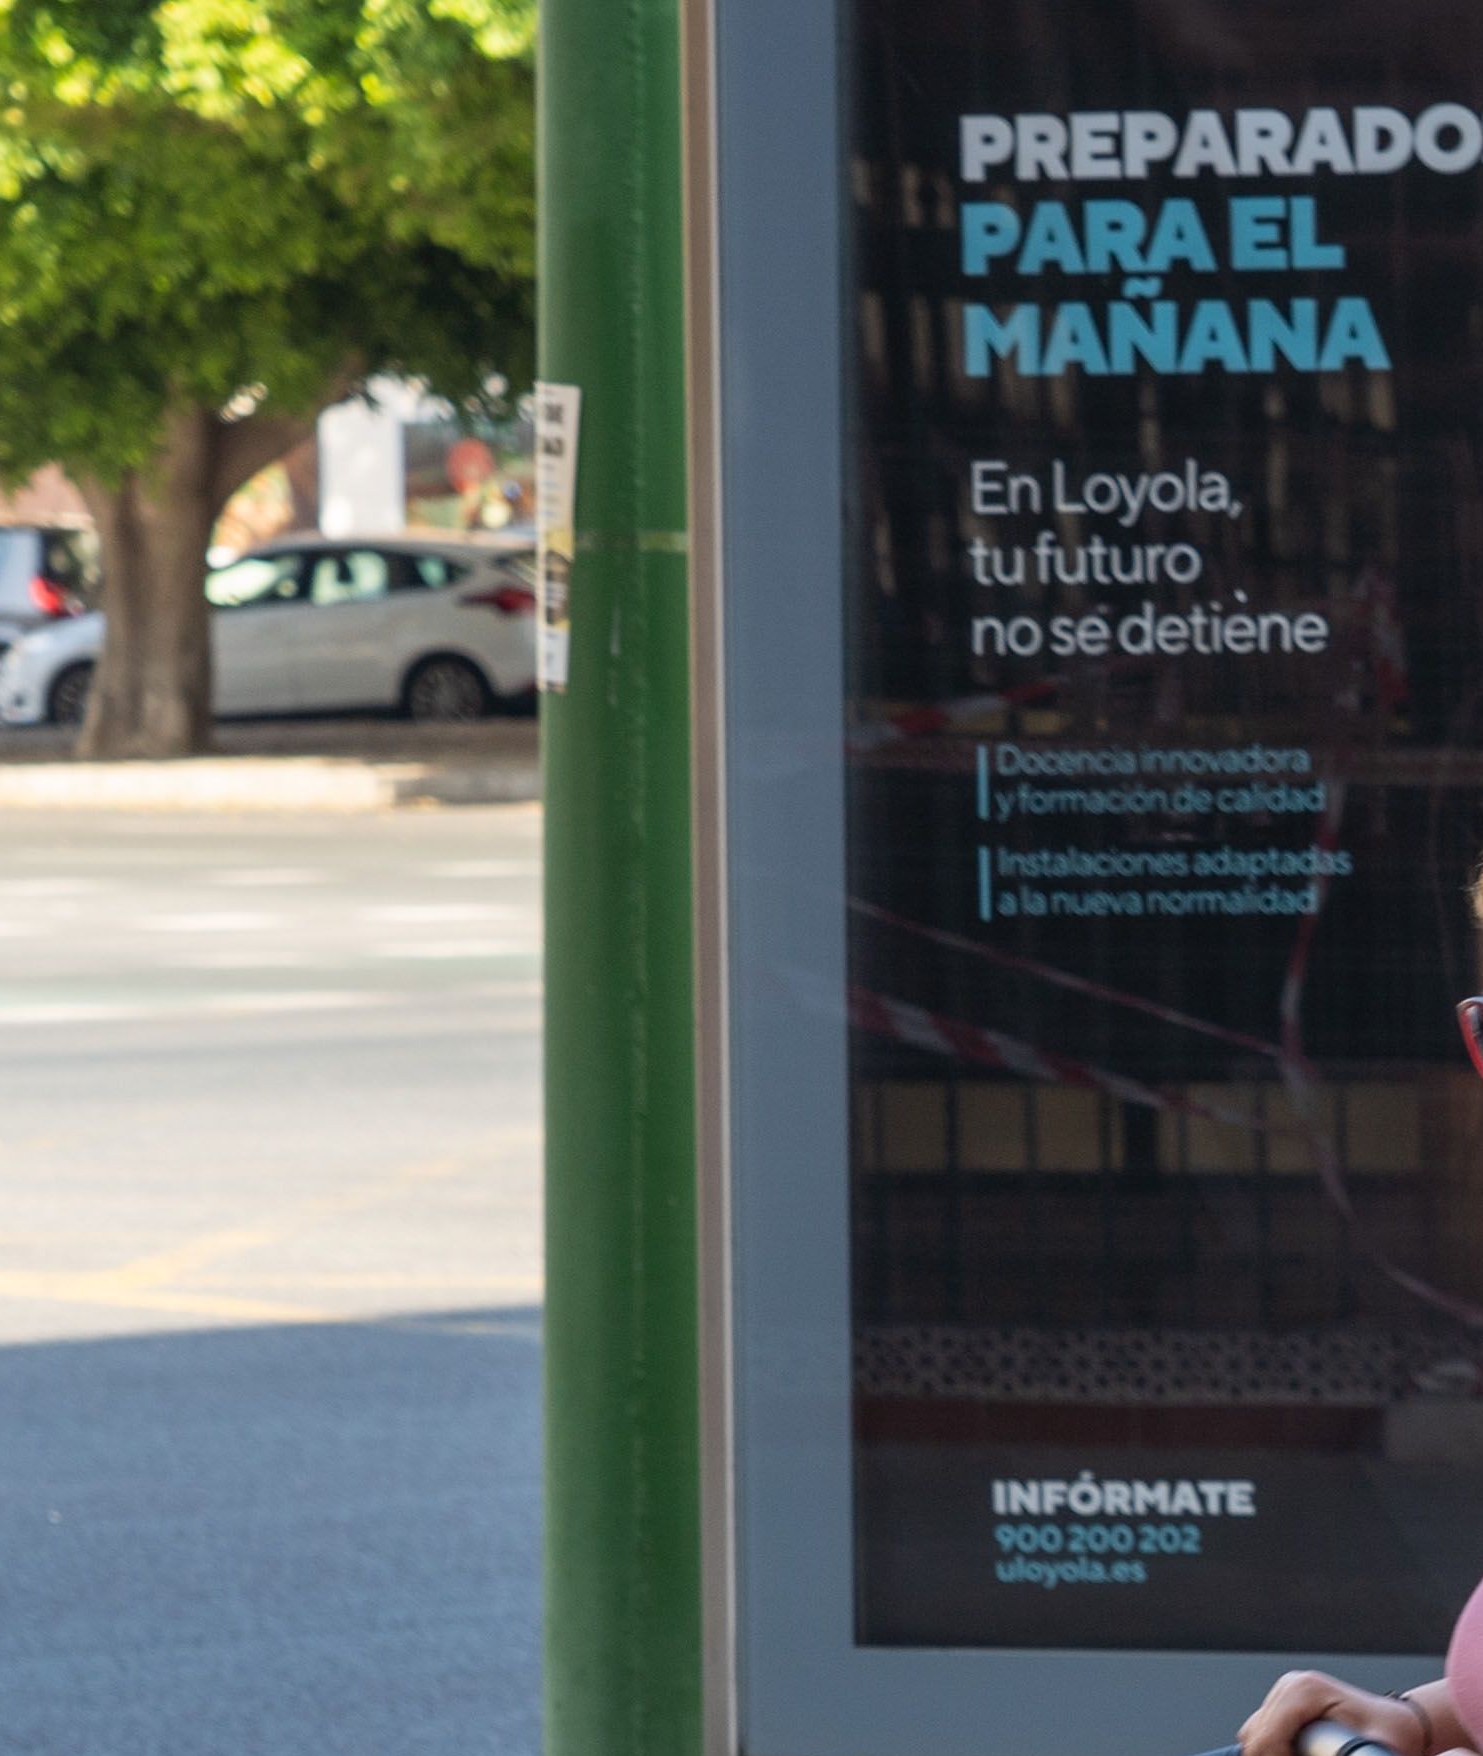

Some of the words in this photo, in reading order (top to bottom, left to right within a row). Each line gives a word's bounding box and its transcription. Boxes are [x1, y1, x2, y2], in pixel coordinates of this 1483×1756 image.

[960, 198, 1218, 276] PARA
[1228, 195, 1346, 271] EL
[963, 275, 1393, 378] MAÑANA
[970, 460, 1042, 515] En
[1051, 457, 1244, 528] Loyola,
[968, 536, 1026, 586] tu
[1033, 530, 1203, 585] futuro
[971, 614, 1044, 657] no
[1049, 614, 1112, 656] se
[1118, 600, 1330, 656] detiene
[995, 743, 1137, 776] Docencia
[1141, 744, 1312, 775] innovadora
[994, 789, 1016, 823] y
[1019, 782, 1168, 816] formación
[1172, 784, 1214, 815] de
[1217, 782, 1327, 815] calidad
[996, 846, 1190, 877] Instalaciones
[1193, 844, 1354, 883] adaptadas
[997, 890, 1019, 916] a
[1021, 883, 1048, 916] la
[1051, 889, 1143, 916] nueva
[1147, 883, 1318, 916] normalidad
[990, 1469, 1257, 1517] INFÓRMATE
[995, 1523, 1064, 1553] 900
[1066, 1523, 1135, 1553] 200
[1138, 1523, 1202, 1553] 202
[995, 1554, 1149, 1591] uloyola.es
